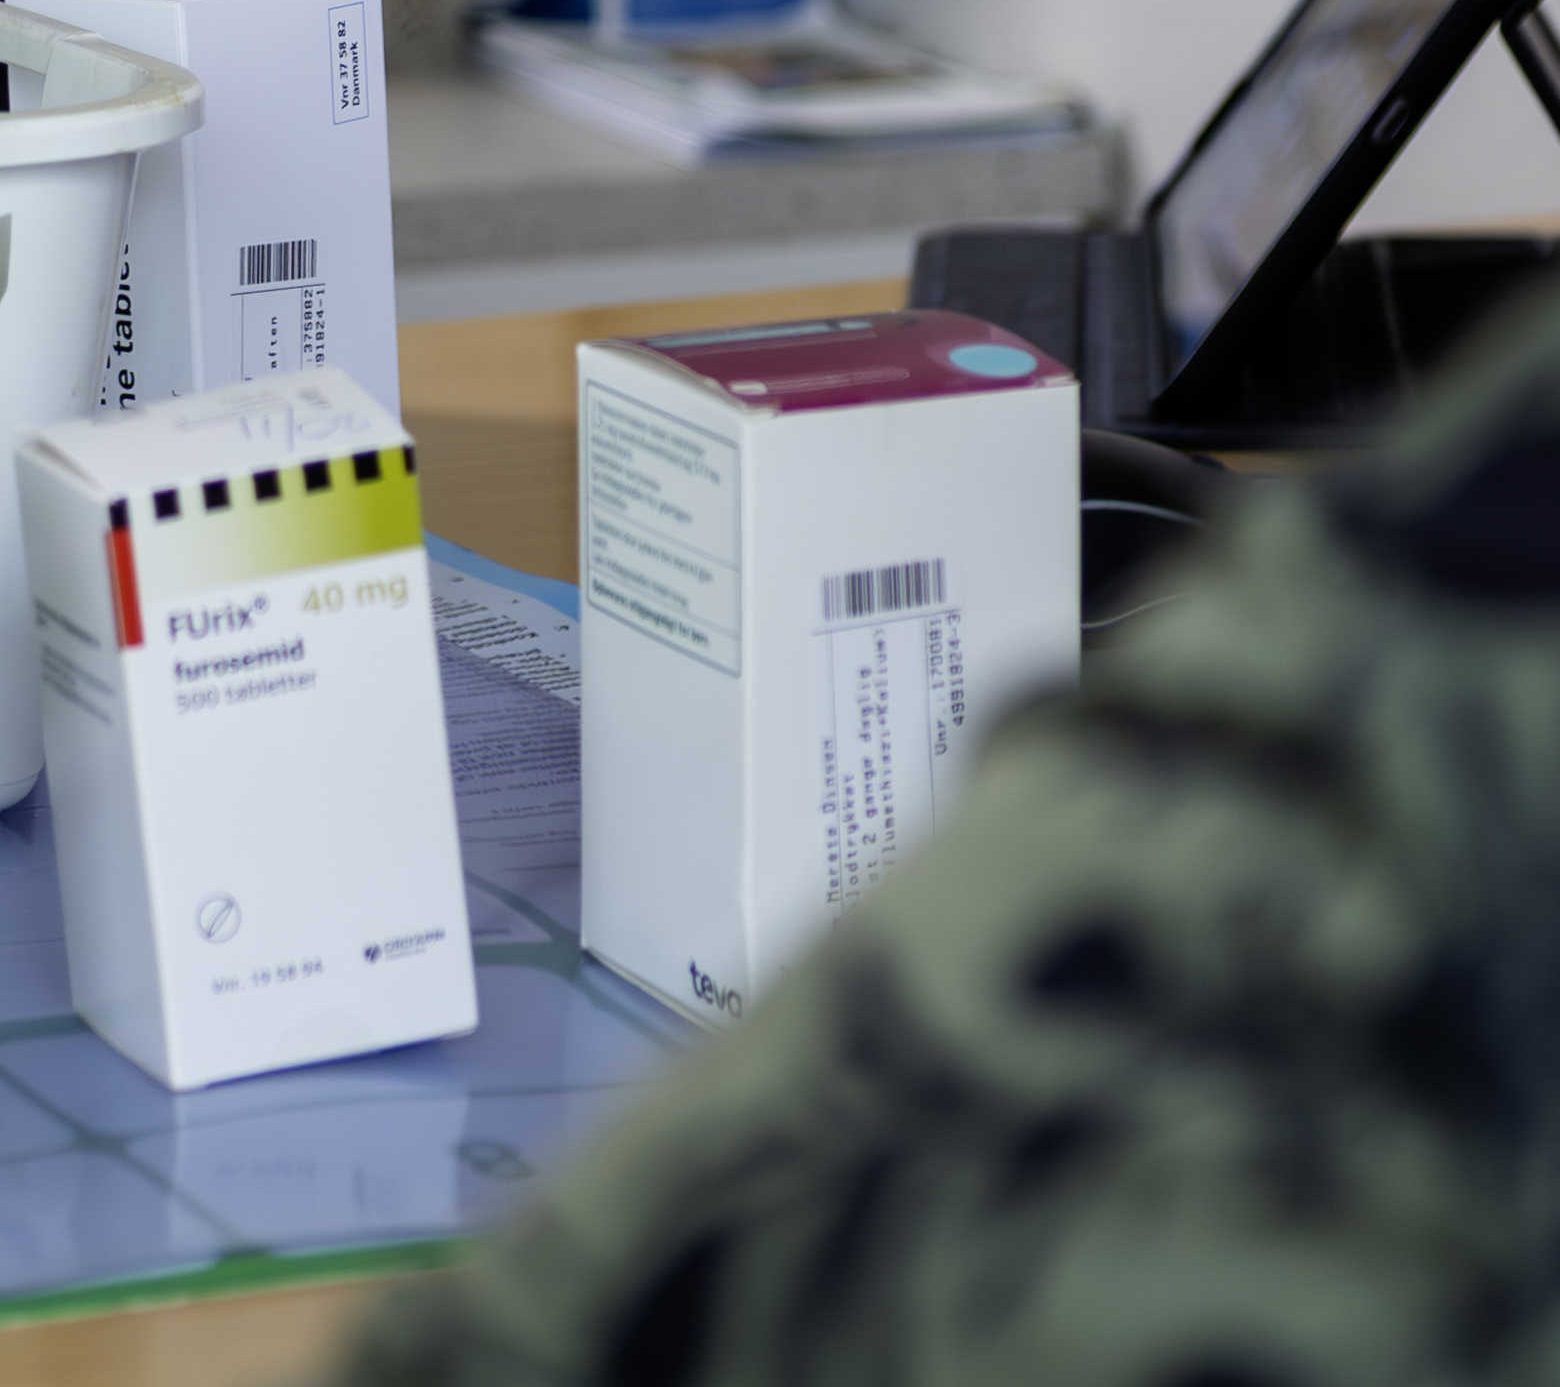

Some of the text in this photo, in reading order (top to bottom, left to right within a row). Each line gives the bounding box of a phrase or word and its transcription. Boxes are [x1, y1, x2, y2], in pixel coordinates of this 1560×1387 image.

[336, 20, 347, 38] 82
[340, 84, 350, 110] Vnr
[350, 41, 361, 107] Danmark
[268, 315, 279, 370] aften
[314, 287, 326, 368] 91824-1
[302, 581, 345, 614] 40
[356, 575, 409, 610] mg
[175, 635, 305, 683] furosemid
[843, 775, 861, 898] lodtrykket
[862, 832, 877, 846] 2
[689, 960, 743, 1020] teva
